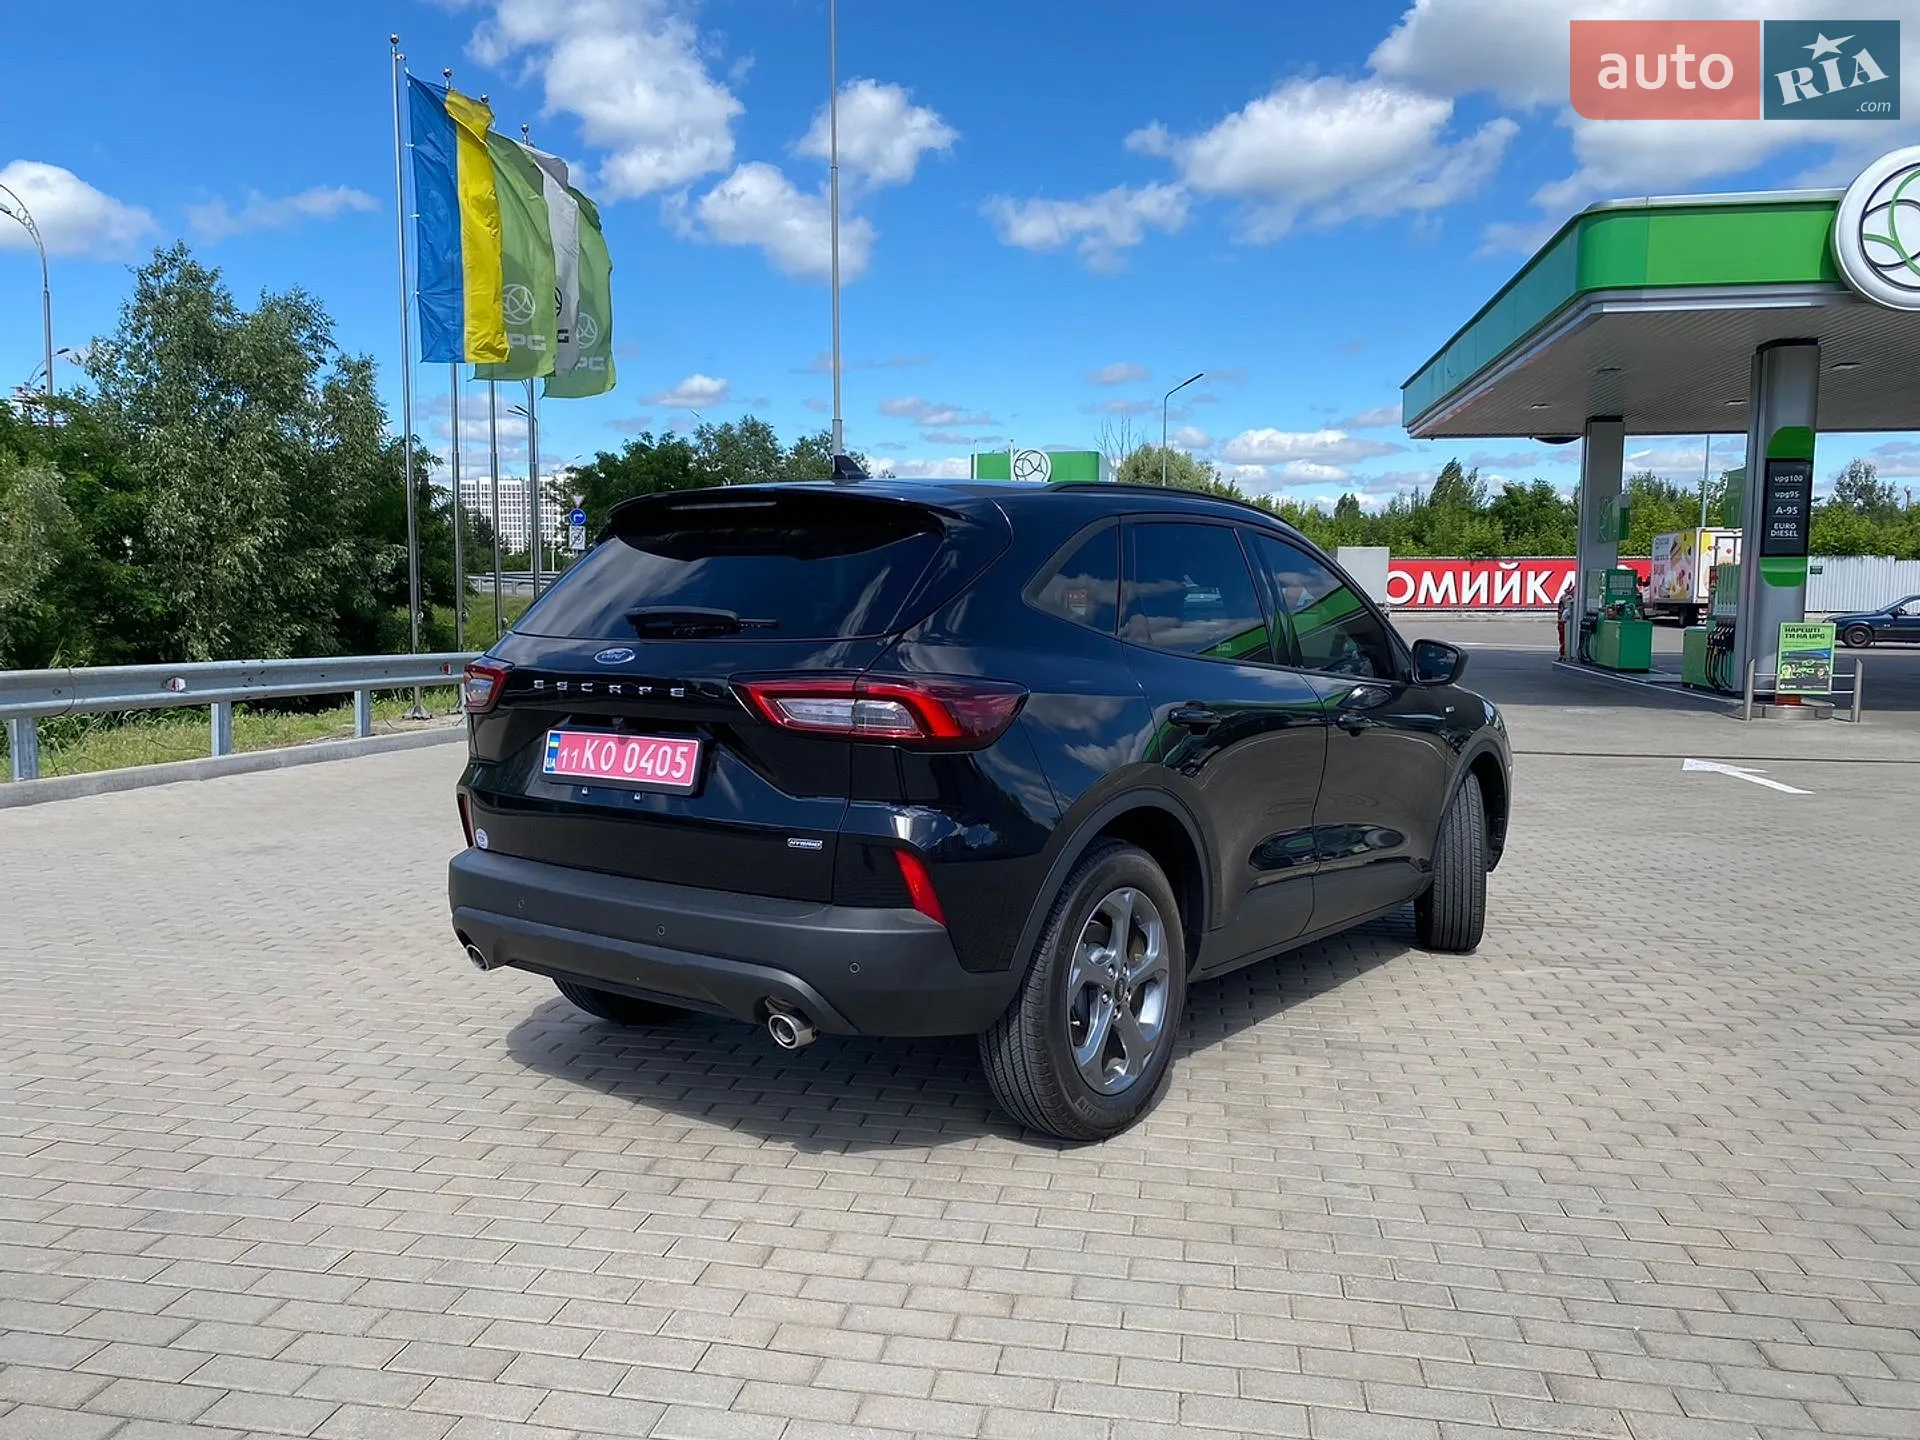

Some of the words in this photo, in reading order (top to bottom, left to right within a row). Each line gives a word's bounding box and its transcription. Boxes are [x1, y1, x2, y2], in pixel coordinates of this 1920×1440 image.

[508, 333, 547, 351] PG
[575, 357, 606, 371] PG
[1774, 475, 1804, 483] upg100
[1774, 491, 1800, 499] upg95
[1775, 506, 1799, 515] A-95
[1773, 522, 1797, 530] EURO
[534, 679, 685, 698] ESCAPE
[546, 757, 556, 768] UA
[623, 742, 688, 779] 0405
